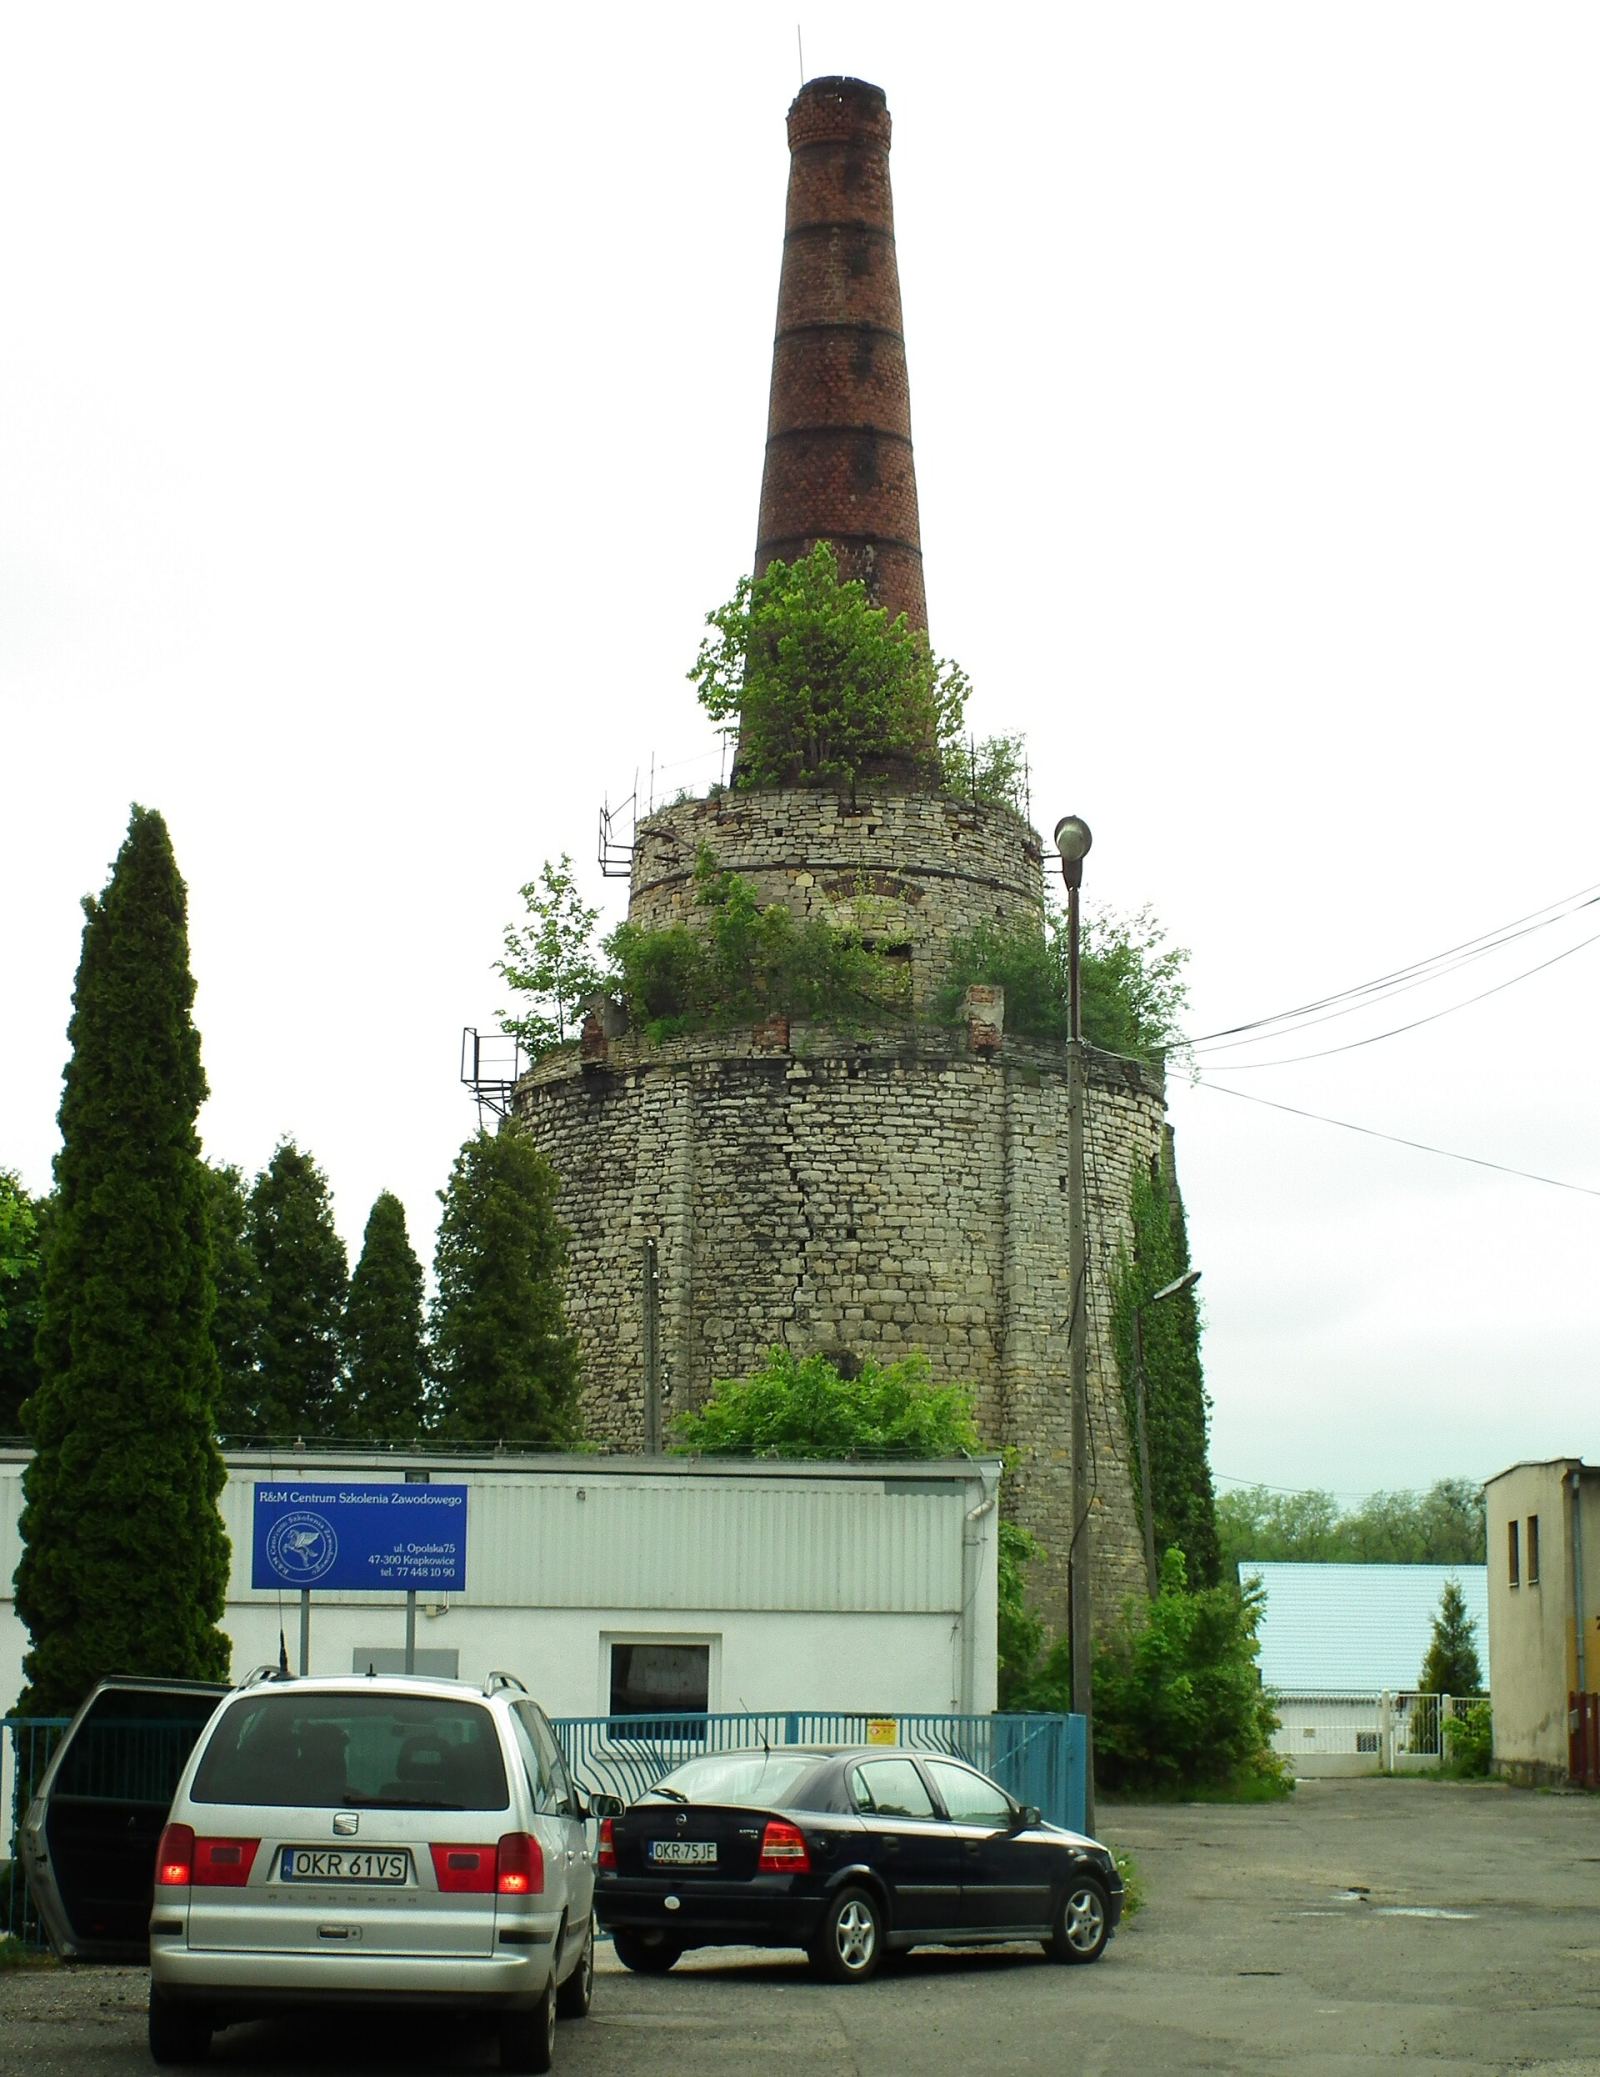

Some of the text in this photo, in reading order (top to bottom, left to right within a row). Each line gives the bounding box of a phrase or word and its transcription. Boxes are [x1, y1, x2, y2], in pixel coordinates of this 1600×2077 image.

[260, 1491, 462, 1507] R&M Centrum Szkolenia Zawodowego
[393, 1543, 405, 1553] ul.
[368, 1555, 456, 1566] 47-300 Krapkowice
[380, 1567, 456, 1577] tel. 77 448 10 90
[656, 1843, 715, 1860] OKR 75JF
[296, 1852, 342, 1875] OKR
[349, 1855, 403, 1878] 61VS
